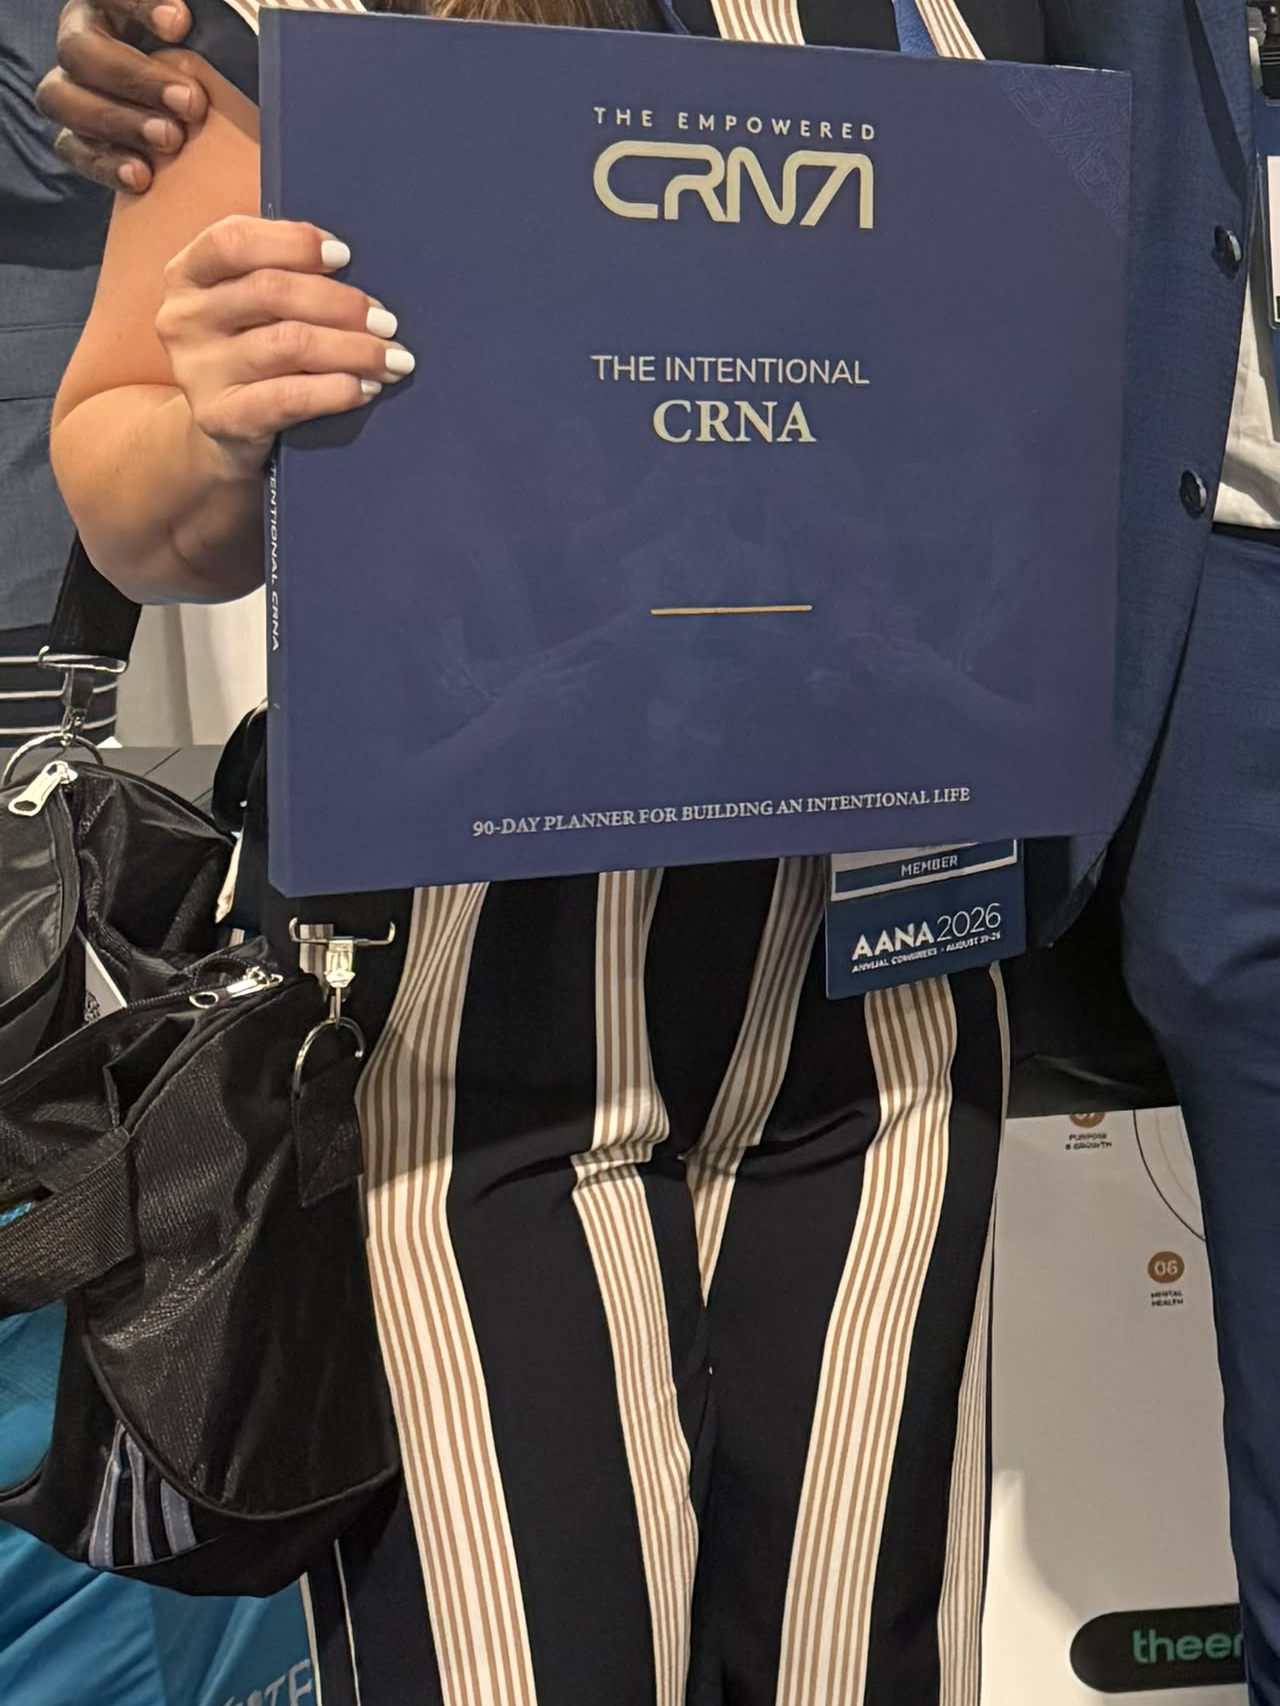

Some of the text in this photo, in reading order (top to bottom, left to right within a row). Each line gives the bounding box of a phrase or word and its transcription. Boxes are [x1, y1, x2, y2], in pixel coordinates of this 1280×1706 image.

[594, 107, 875, 140] THE EMPOWERED
[593, 140, 874, 229] CRNA
[591, 355, 870, 384] THE INTENTIONAL
[653, 400, 817, 443] CRNA
[269, 466, 279, 585] TENTIONAL
[473, 787, 970, 837] 90-DAY PLANNER FOR BUILDING AN INTENTIONAL LIFE
[901, 855, 958, 877] MEMBER
[1154, 1260, 1178, 1276] 06
